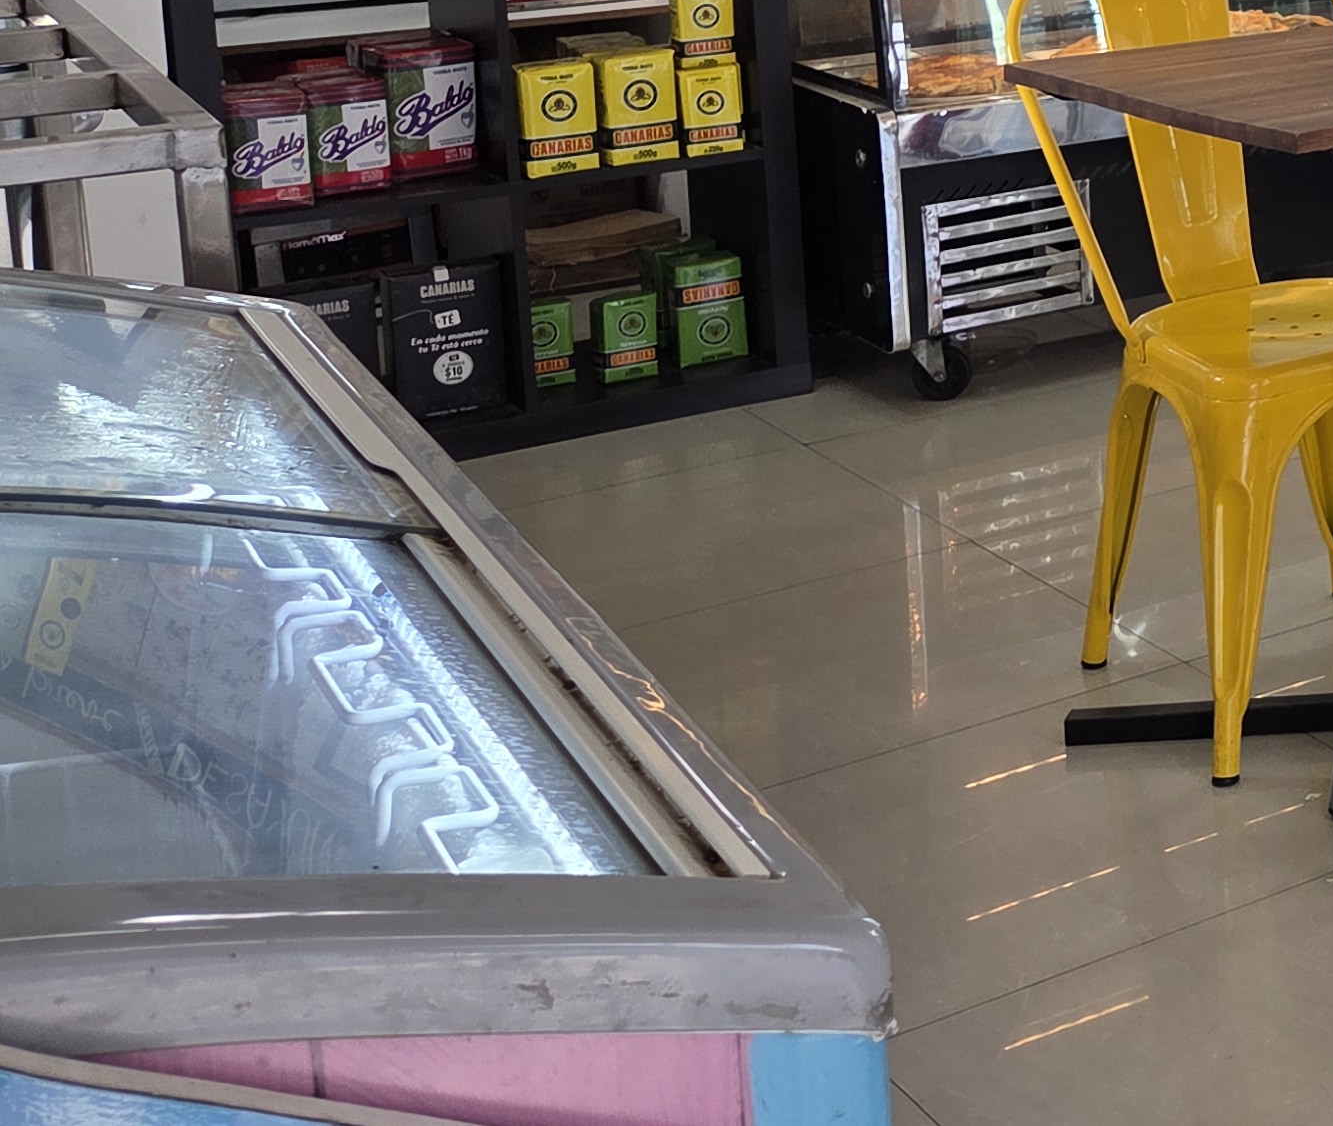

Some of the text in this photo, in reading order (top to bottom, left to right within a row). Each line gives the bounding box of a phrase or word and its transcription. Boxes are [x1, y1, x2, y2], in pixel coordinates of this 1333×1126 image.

[685, 38, 732, 55] CANARIAS
[394, 79, 474, 140] Baldo
[318, 115, 386, 162] Baldo
[613, 124, 674, 146] CANARIAS
[689, 125, 738, 142] CANARIAS
[232, 132, 305, 179] Baldo
[530, 136, 594, 157] CANARIAS
[419, 278, 476, 299] CANARIAS
[312, 299, 350, 316] ARIAS
[611, 347, 656, 366] CANARIAS
